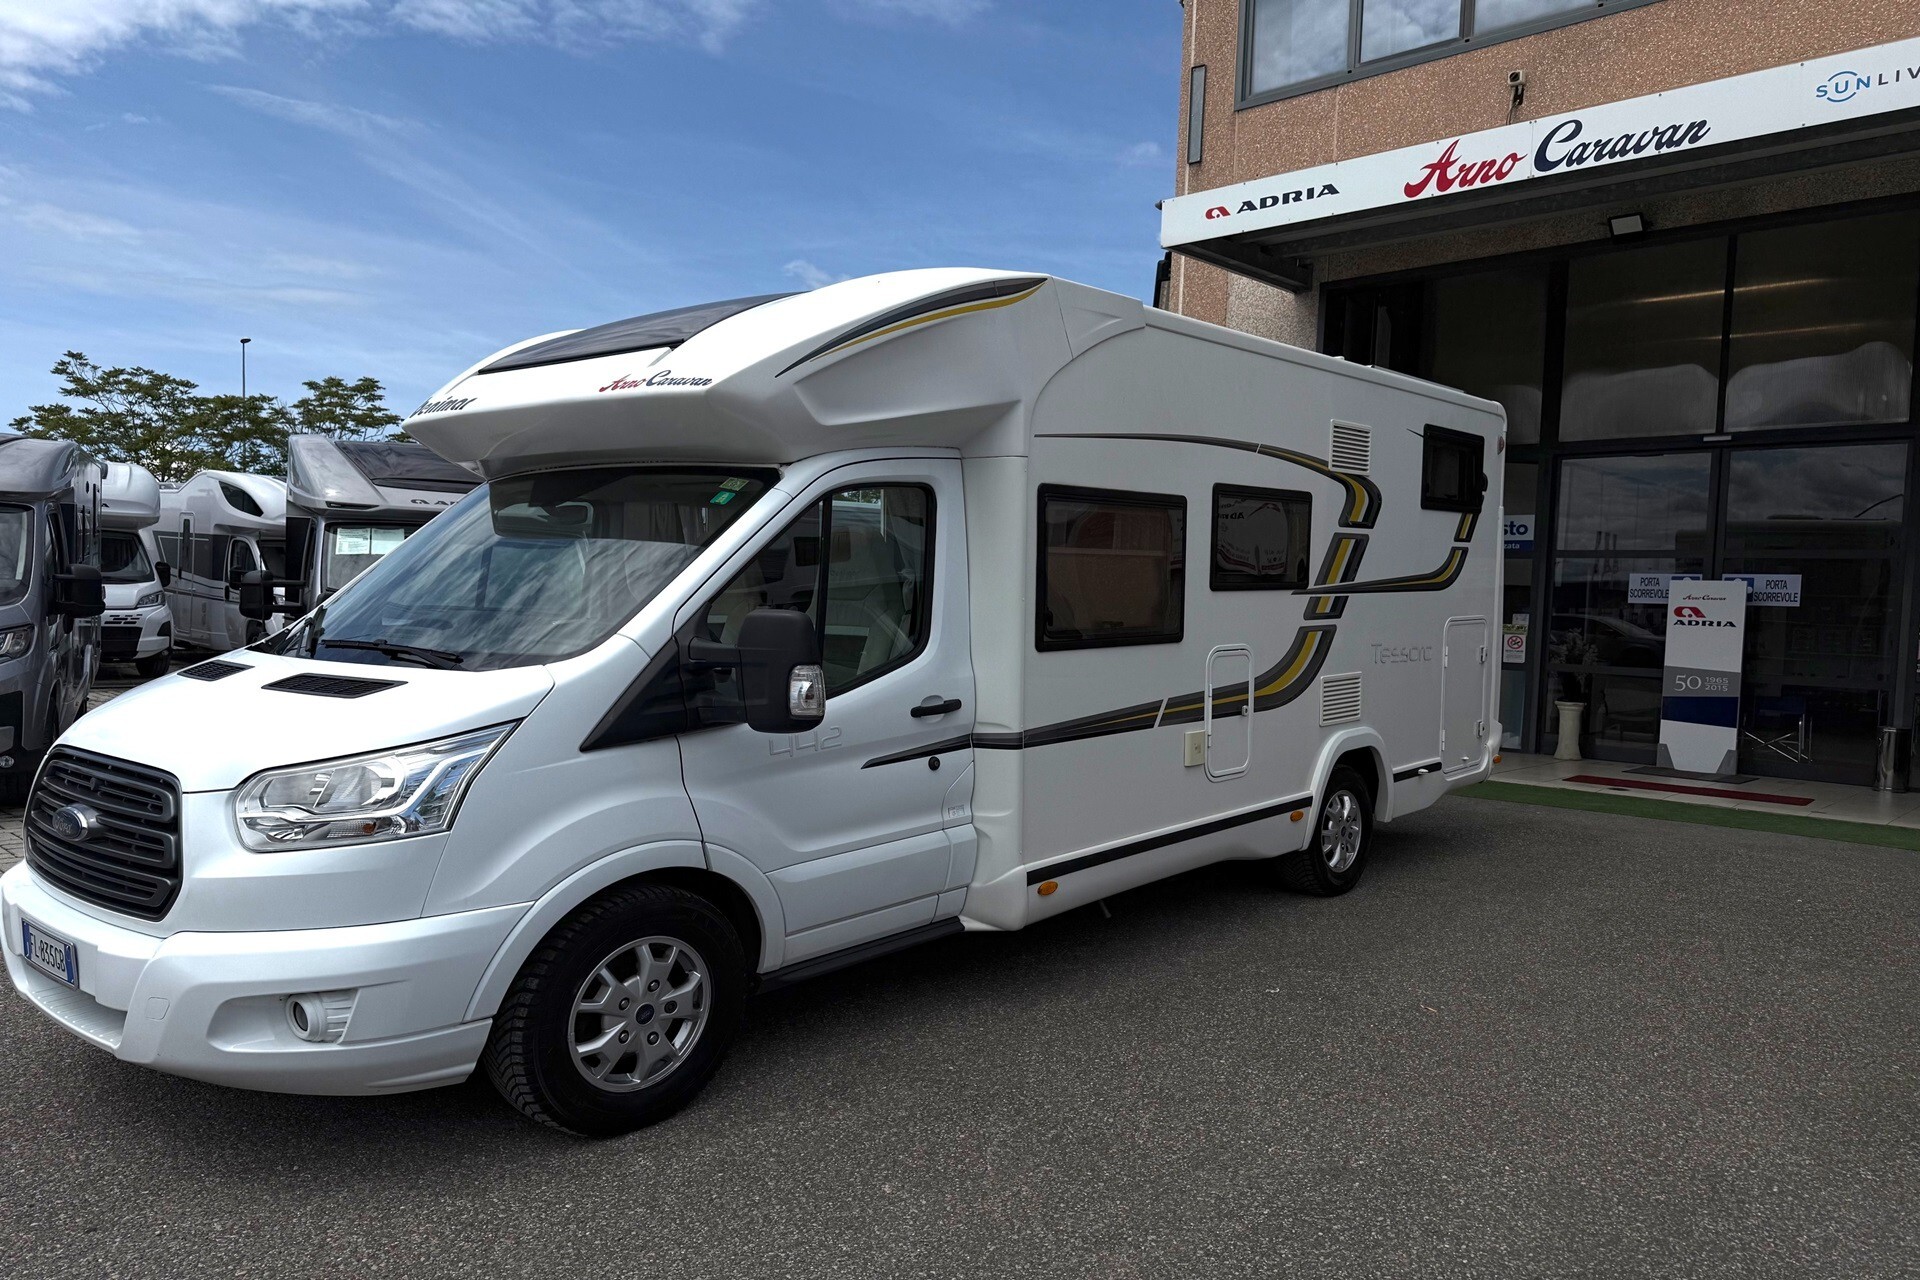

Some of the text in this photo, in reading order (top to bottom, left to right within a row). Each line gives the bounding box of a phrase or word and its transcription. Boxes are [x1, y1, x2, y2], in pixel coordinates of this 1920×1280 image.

[1404, 119, 1711, 198] Arno Caravan
[1236, 183, 1340, 214] ADRIA
[600, 369, 713, 392] Arno Caravan
[1640, 577, 1660, 587] PORTA
[1765, 579, 1788, 590] PORTA
[1629, 588, 1669, 599] SCORREVOLE
[1753, 592, 1798, 603] SCORREVOLE
[1673, 619, 1737, 628] ADRIA
[1674, 674, 1702, 692] 50
[1705, 676, 1729, 684] 1965
[1705, 684, 1728, 692] 2015
